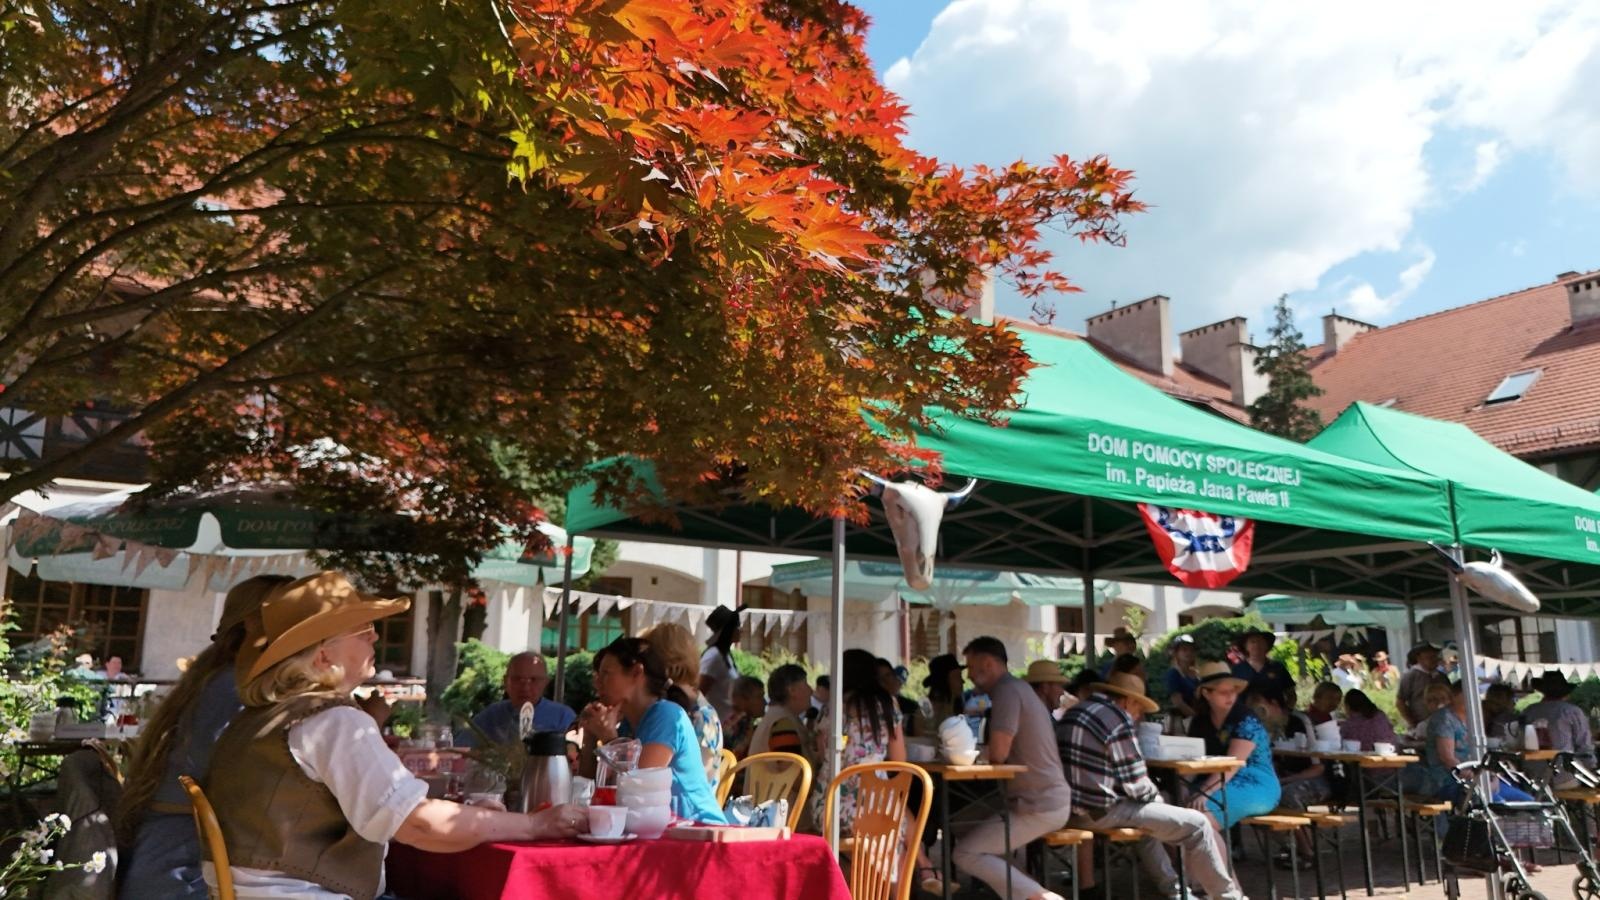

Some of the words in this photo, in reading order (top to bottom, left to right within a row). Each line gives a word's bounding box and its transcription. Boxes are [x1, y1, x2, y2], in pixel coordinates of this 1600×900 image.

[1088, 433, 1129, 458] DOM
[1132, 442, 1203, 471] POMOCY
[1206, 455, 1301, 486] SPOŁECZNEJ
[1106, 462, 1131, 484] im.
[1136, 468, 1196, 494] Papieża
[1200, 479, 1233, 500] Jana
[1237, 485, 1277, 507] Pawła
